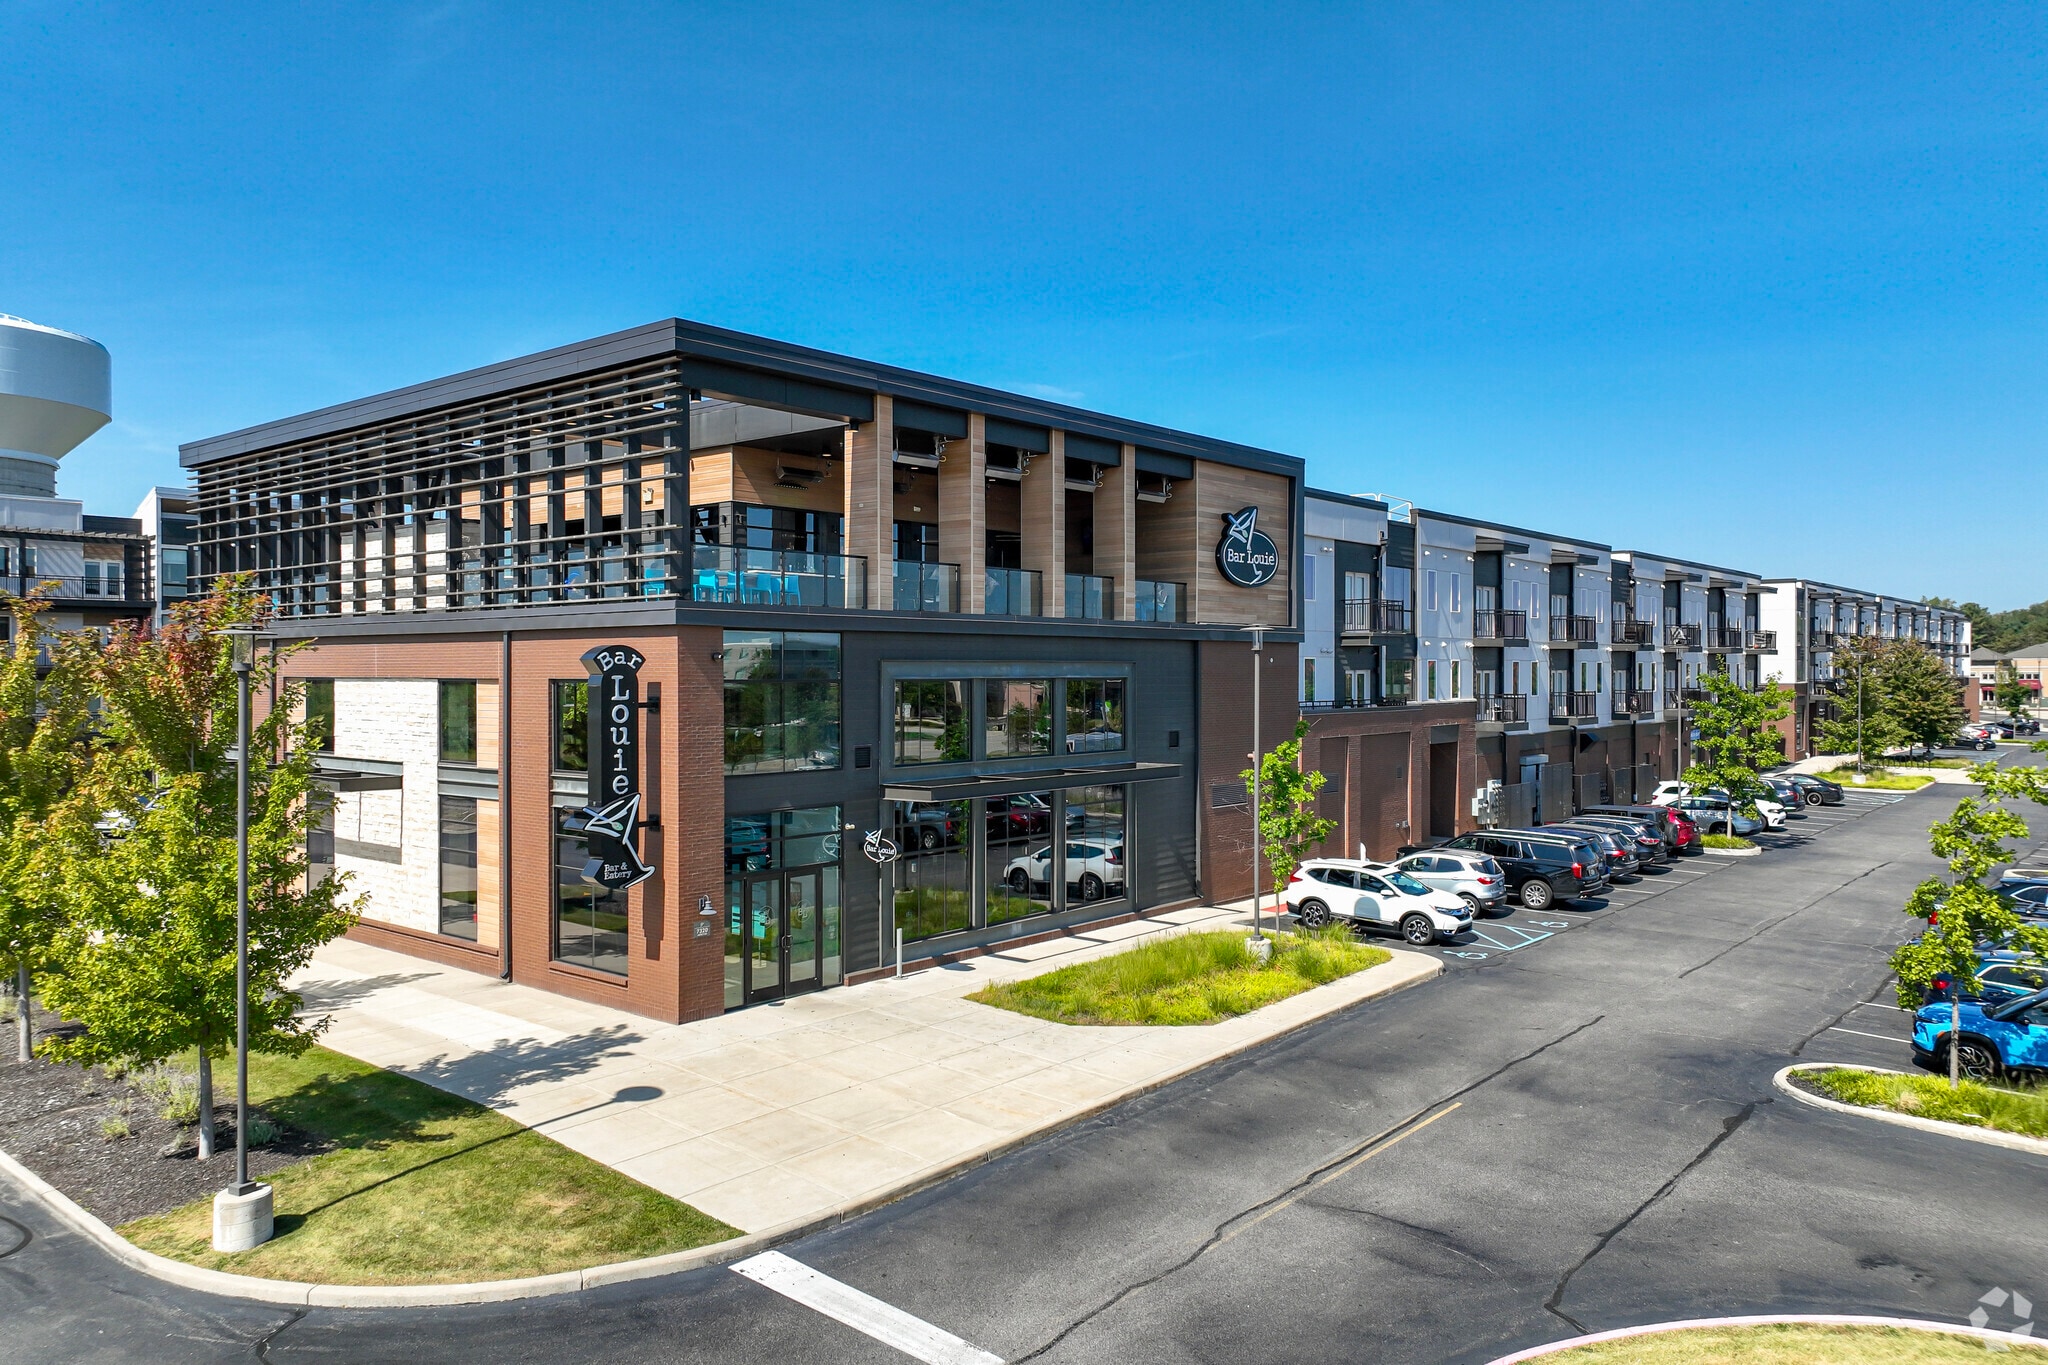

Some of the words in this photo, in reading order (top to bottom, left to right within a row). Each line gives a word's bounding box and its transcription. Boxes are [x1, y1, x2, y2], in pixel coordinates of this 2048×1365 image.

[1227, 548, 1245, 563] Bar
[1247, 550, 1275, 566] Louie
[597, 651, 642, 671] Bar
[610, 675, 631, 795] Louie
[866, 844, 877, 853] Bar
[878, 847, 895, 855] Louie
[604, 863, 619, 872] Bar
[620, 861, 628, 870] &
[604, 870, 632, 880] Eatery
